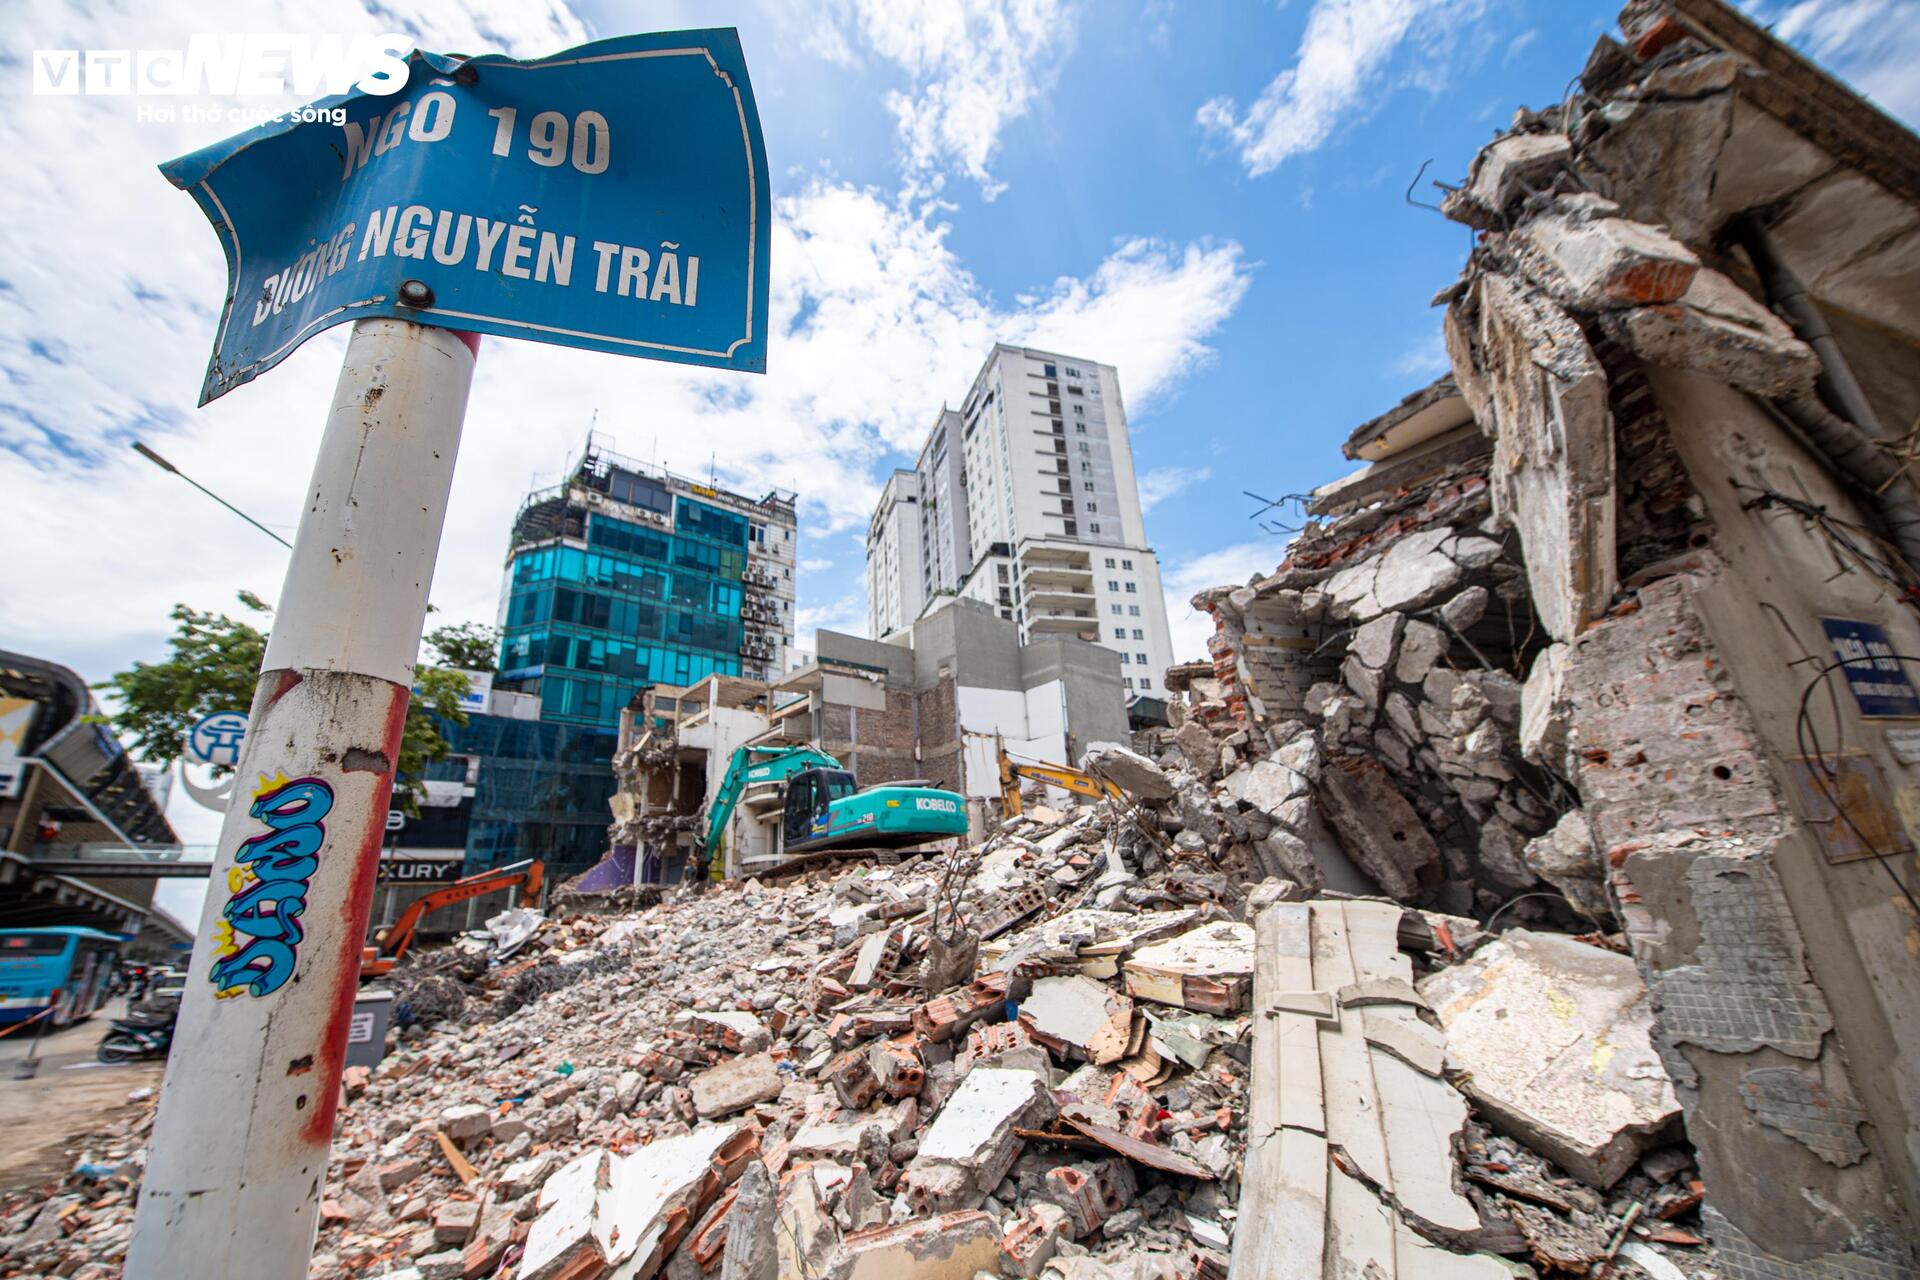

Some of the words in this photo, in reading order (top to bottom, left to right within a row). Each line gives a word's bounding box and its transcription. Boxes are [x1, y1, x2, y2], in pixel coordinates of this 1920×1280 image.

[342, 78, 457, 181] NGÕ
[487, 106, 610, 175] 190
[357, 204, 577, 287] NGUYỄN
[592, 240, 700, 307] TRÃI
[915, 797, 957, 813] KOBELCO
